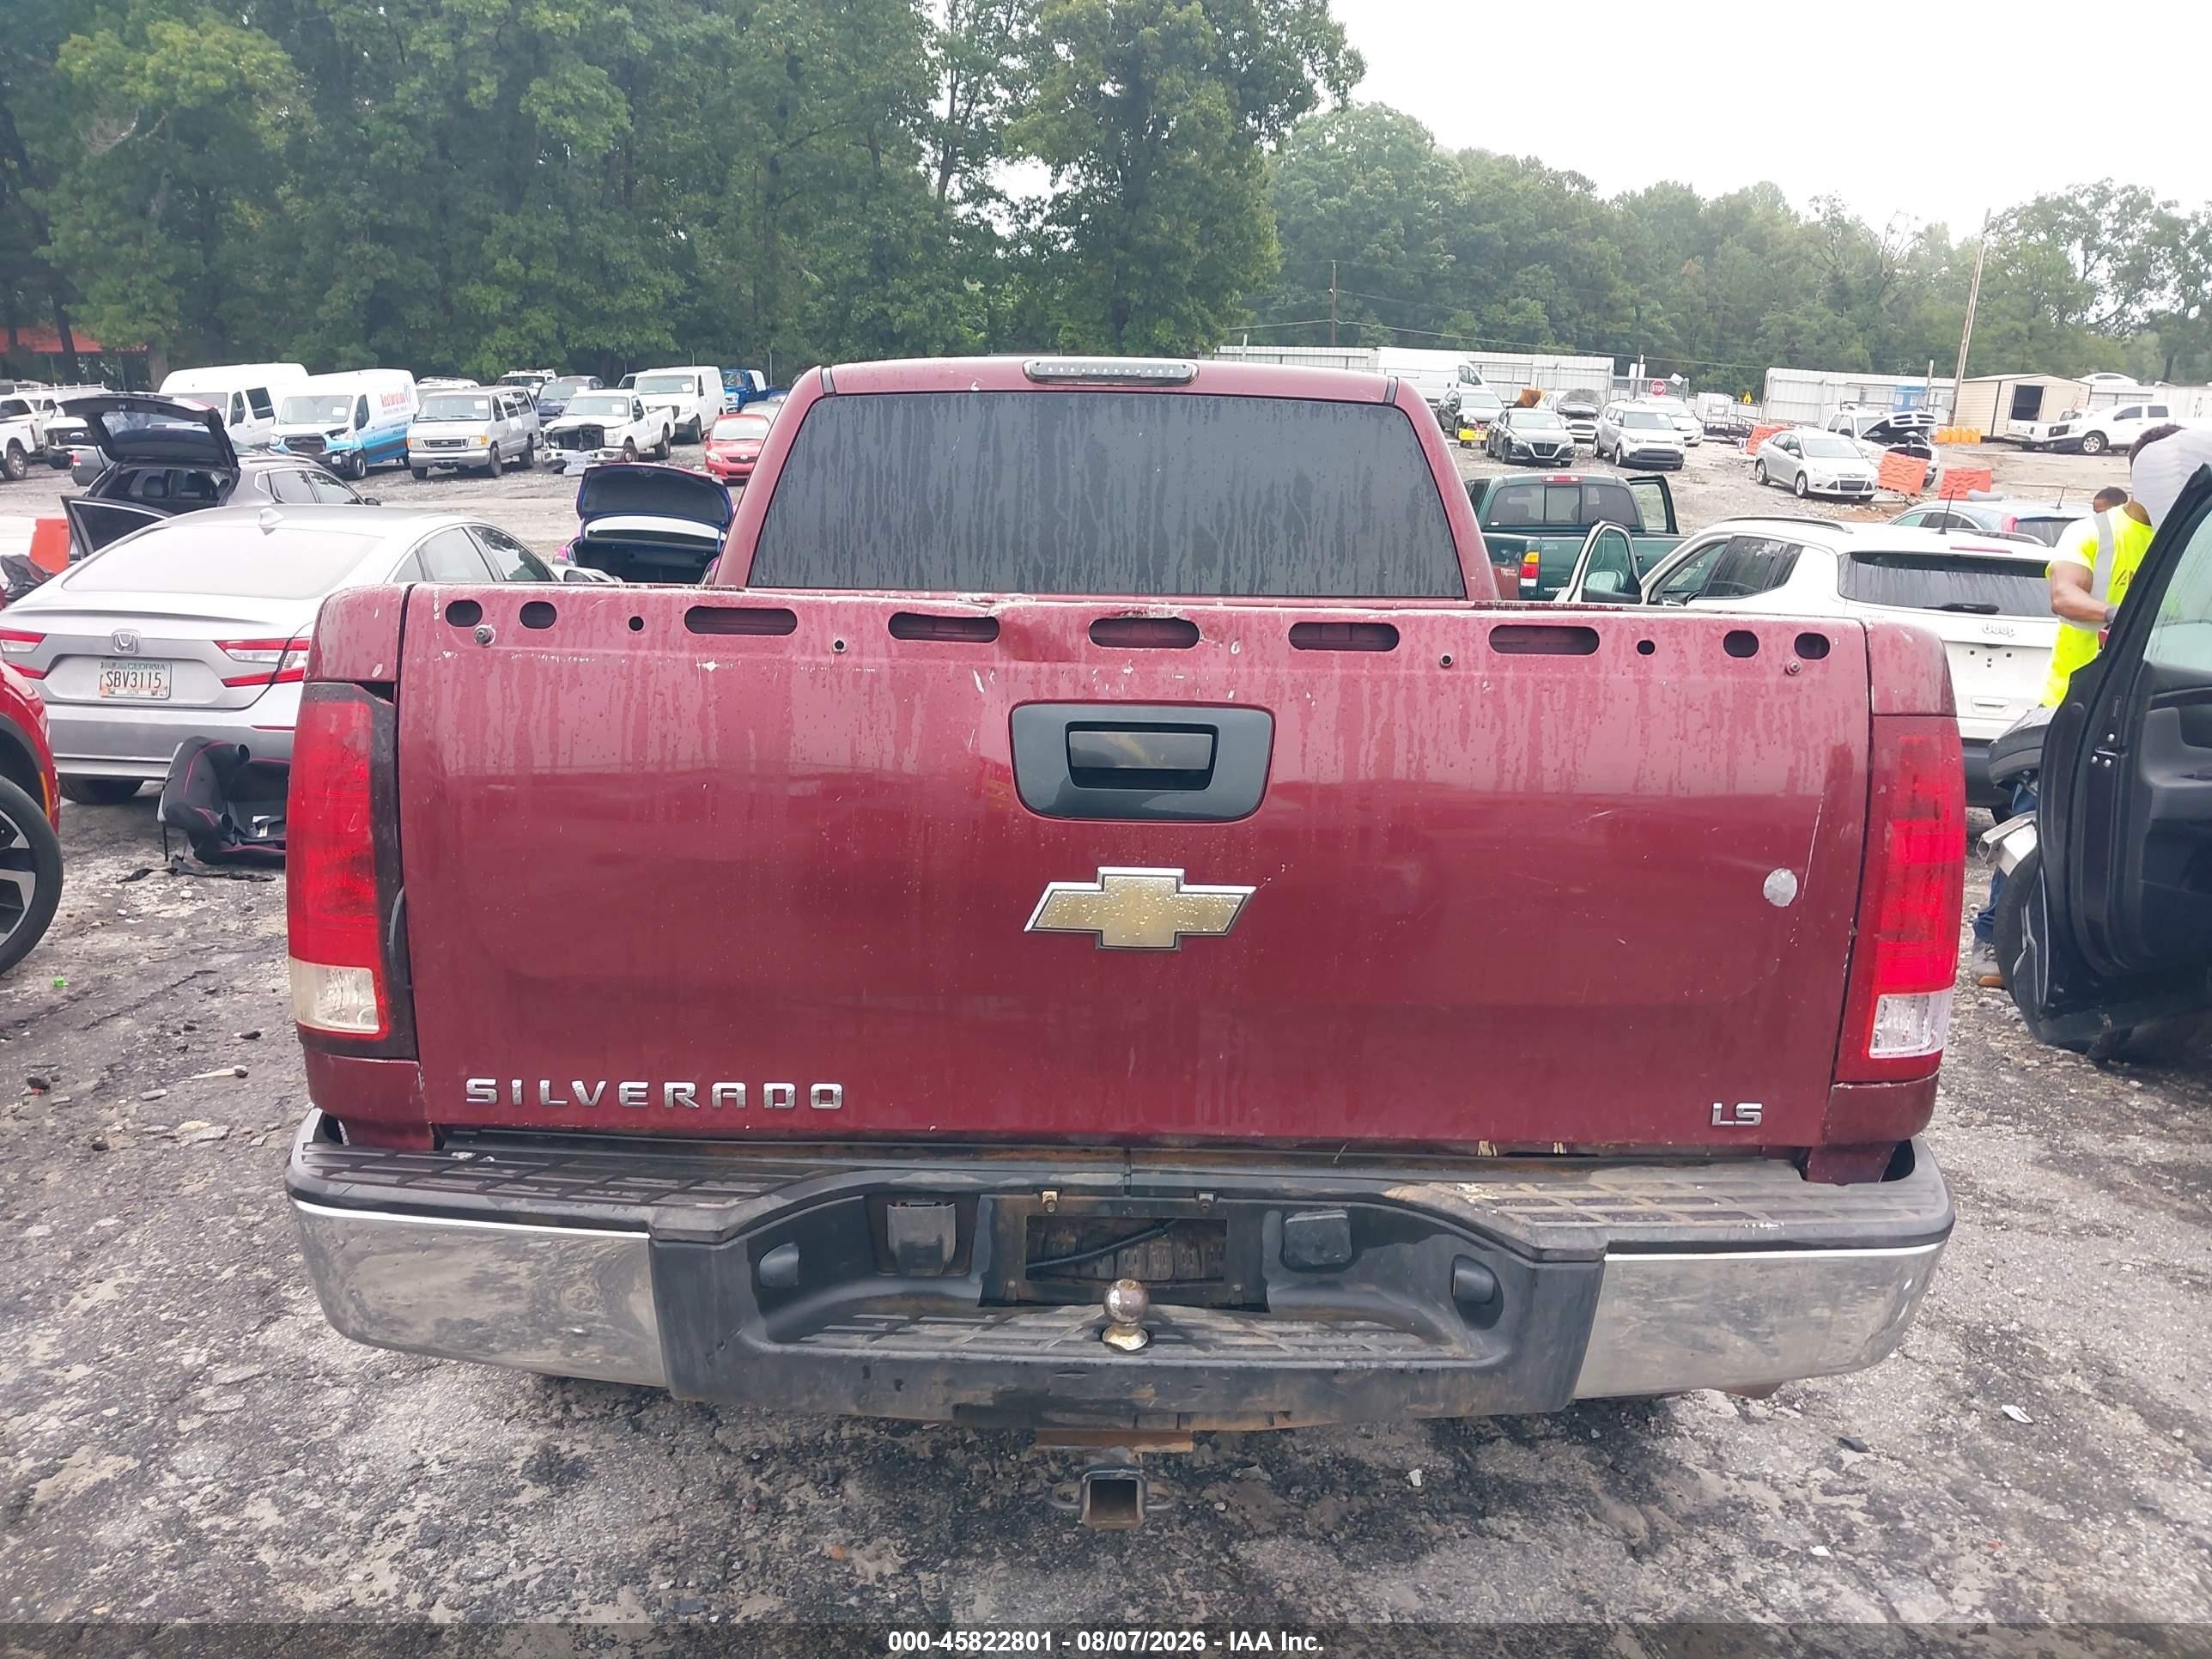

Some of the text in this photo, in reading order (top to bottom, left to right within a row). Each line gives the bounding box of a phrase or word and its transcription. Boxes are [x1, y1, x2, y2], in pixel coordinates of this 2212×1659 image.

[1651, 384, 1665, 392] STOP
[1982, 623, 2015, 638] Jeep
[106, 671, 162, 689] SBV3115
[465, 1078, 845, 1110] SILVERADO
[1711, 1103, 1764, 1127] LS
